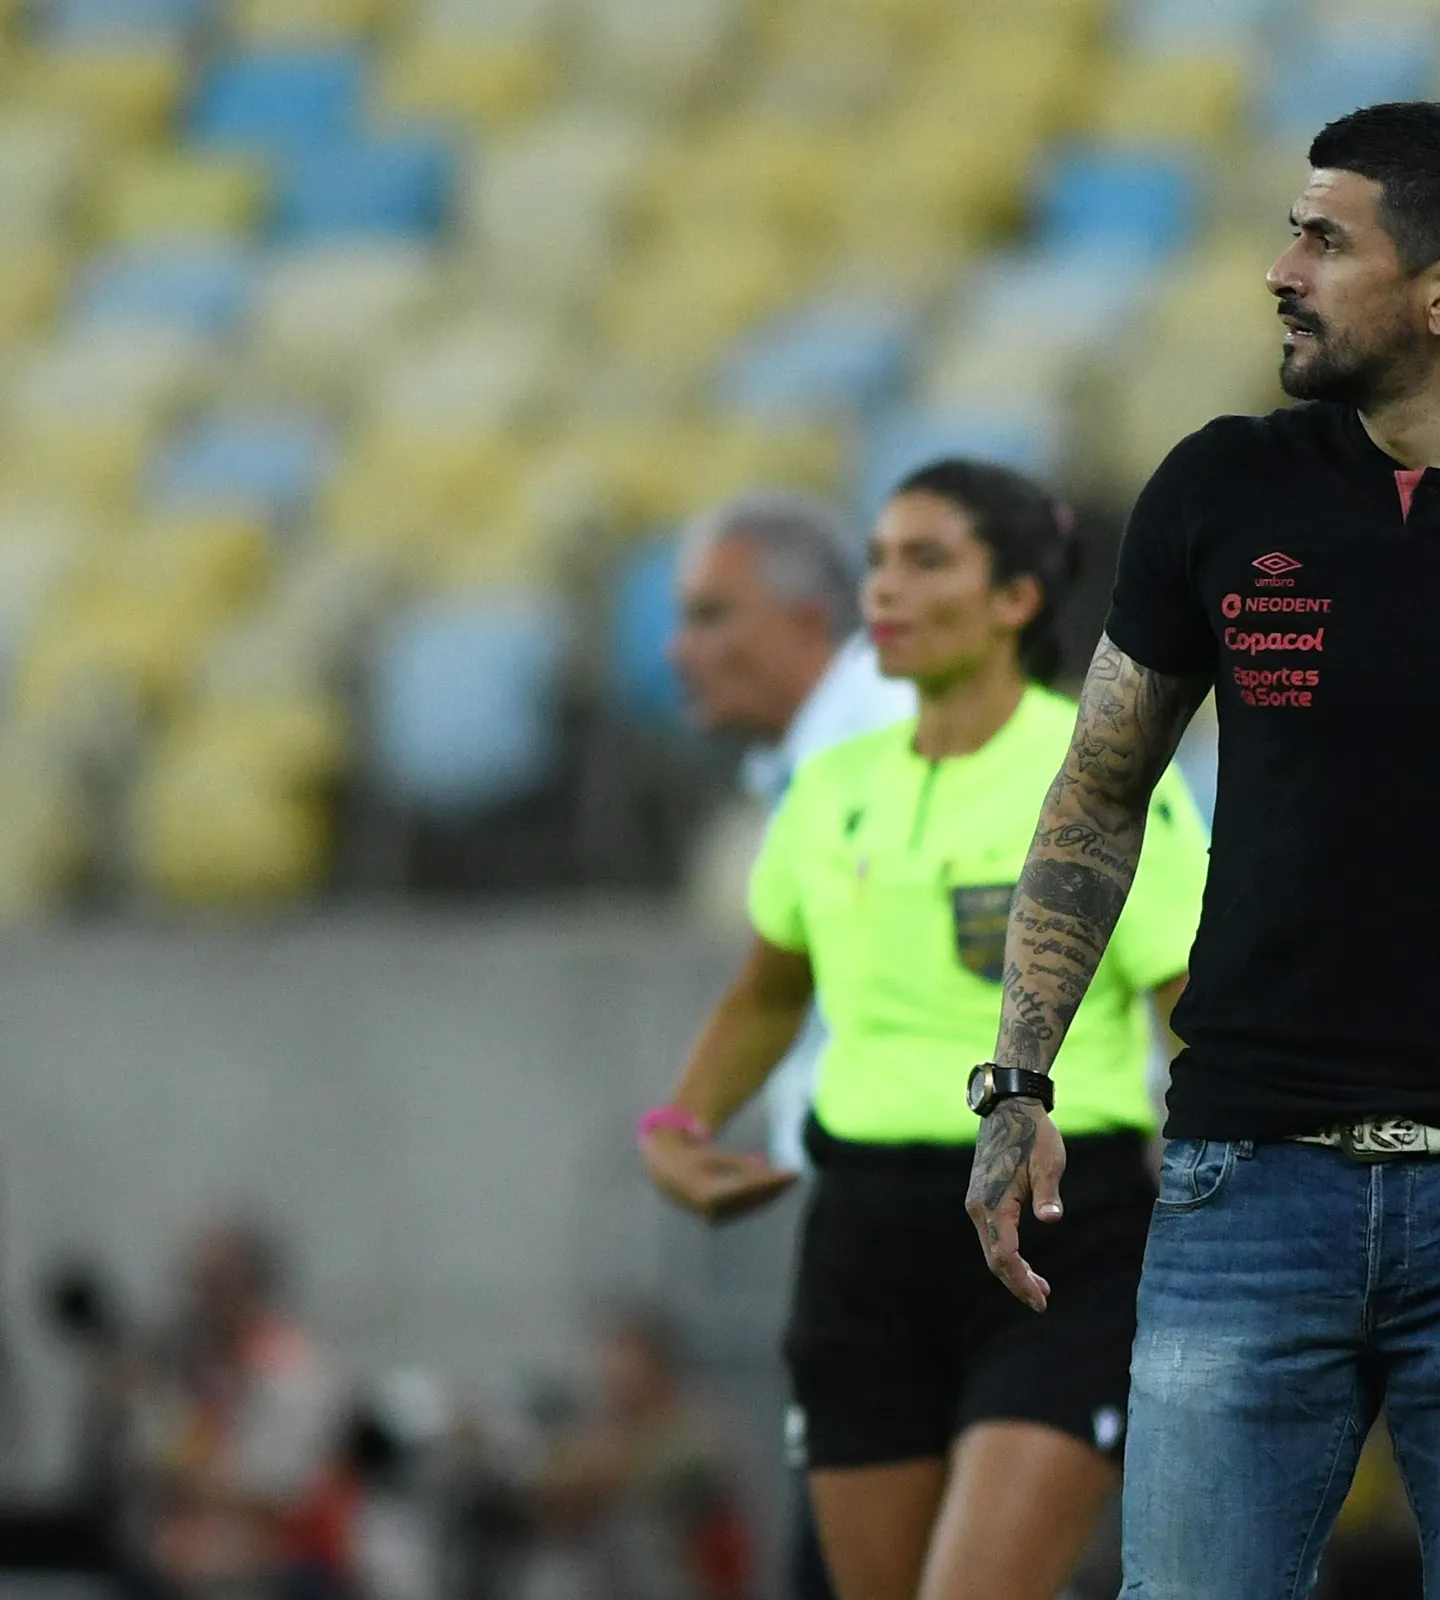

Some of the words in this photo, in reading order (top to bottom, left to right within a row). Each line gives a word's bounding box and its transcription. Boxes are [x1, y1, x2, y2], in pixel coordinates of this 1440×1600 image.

[1254, 576, 1295, 588] umbro
[1245, 597, 1332, 613] NEODENT
[1224, 626, 1325, 656] Copacol
[1233, 666, 1320, 688] Esportes
[1256, 687, 1313, 707] Sorte
